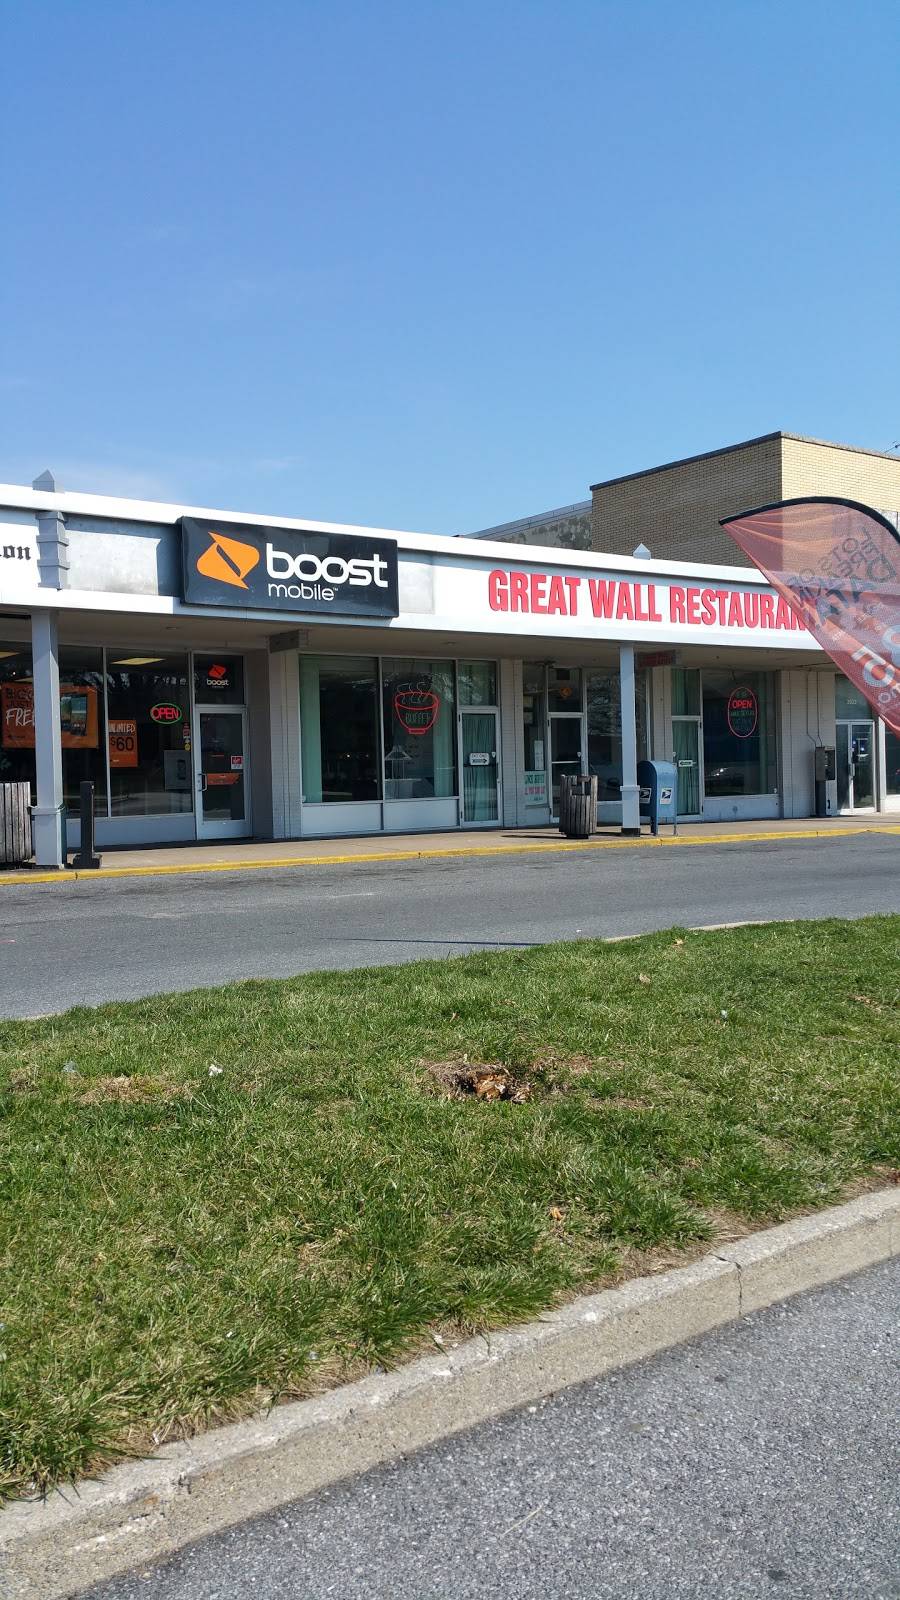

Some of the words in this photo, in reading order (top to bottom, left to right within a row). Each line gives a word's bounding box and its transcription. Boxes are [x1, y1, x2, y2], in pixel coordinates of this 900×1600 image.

[0, 545, 31, 560] on
[266, 543, 388, 587] boost
[268, 583, 335, 601] mobile
[488, 570, 581, 616] GREAT
[588, 579, 662, 622] WALL
[669, 586, 806, 631] RESTAURAN
[732, 700, 752, 709] OPEN
[151, 707, 179, 719] OPEN
[110, 736, 135, 751] $60
